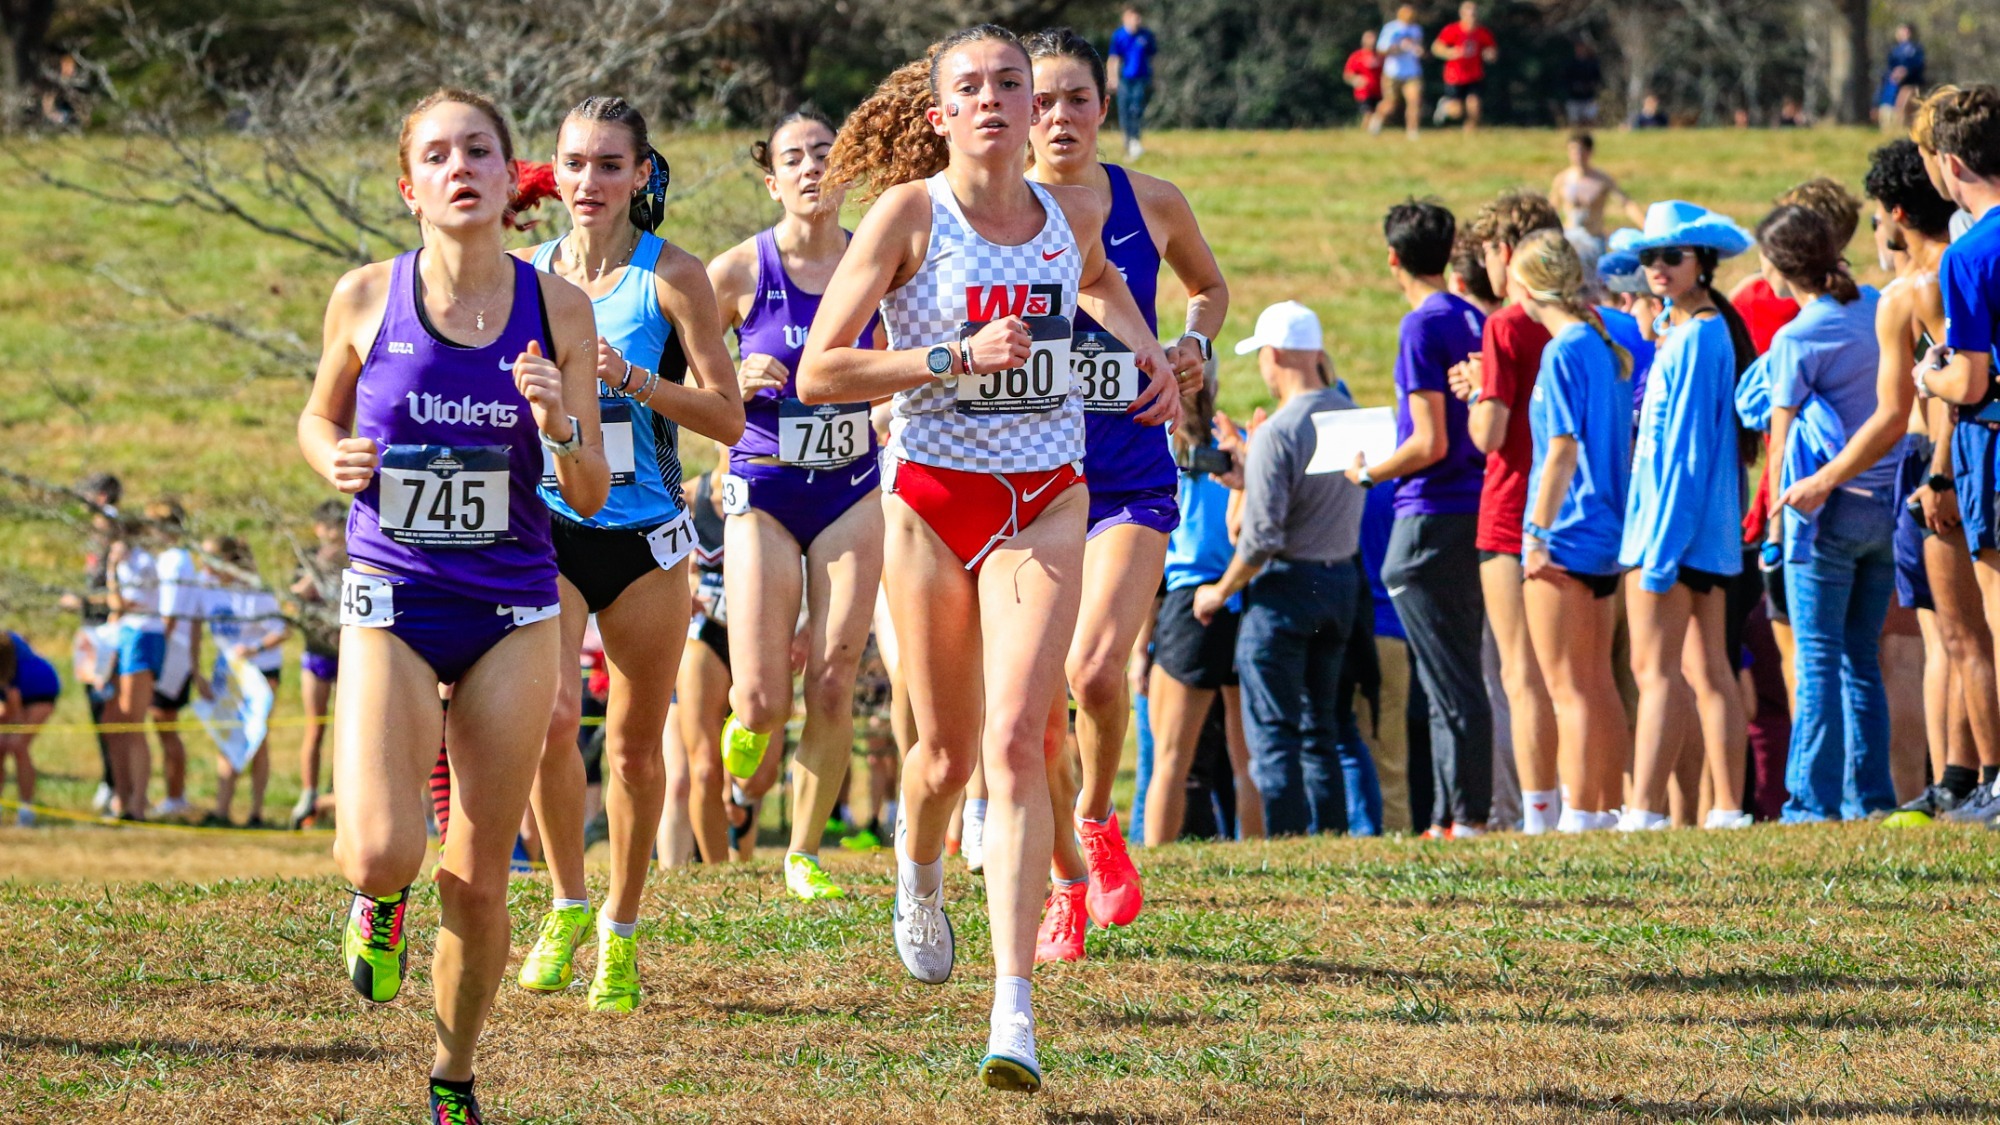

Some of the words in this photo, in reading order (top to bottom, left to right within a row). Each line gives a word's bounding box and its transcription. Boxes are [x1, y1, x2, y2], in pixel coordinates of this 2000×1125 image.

[767, 289, 787, 300] UAA
[965, 283, 1062, 322] W&J
[387, 341, 415, 355] UAA
[405, 390, 519, 428] Violets
[795, 420, 854, 461] 743
[402, 478, 485, 531] 745
